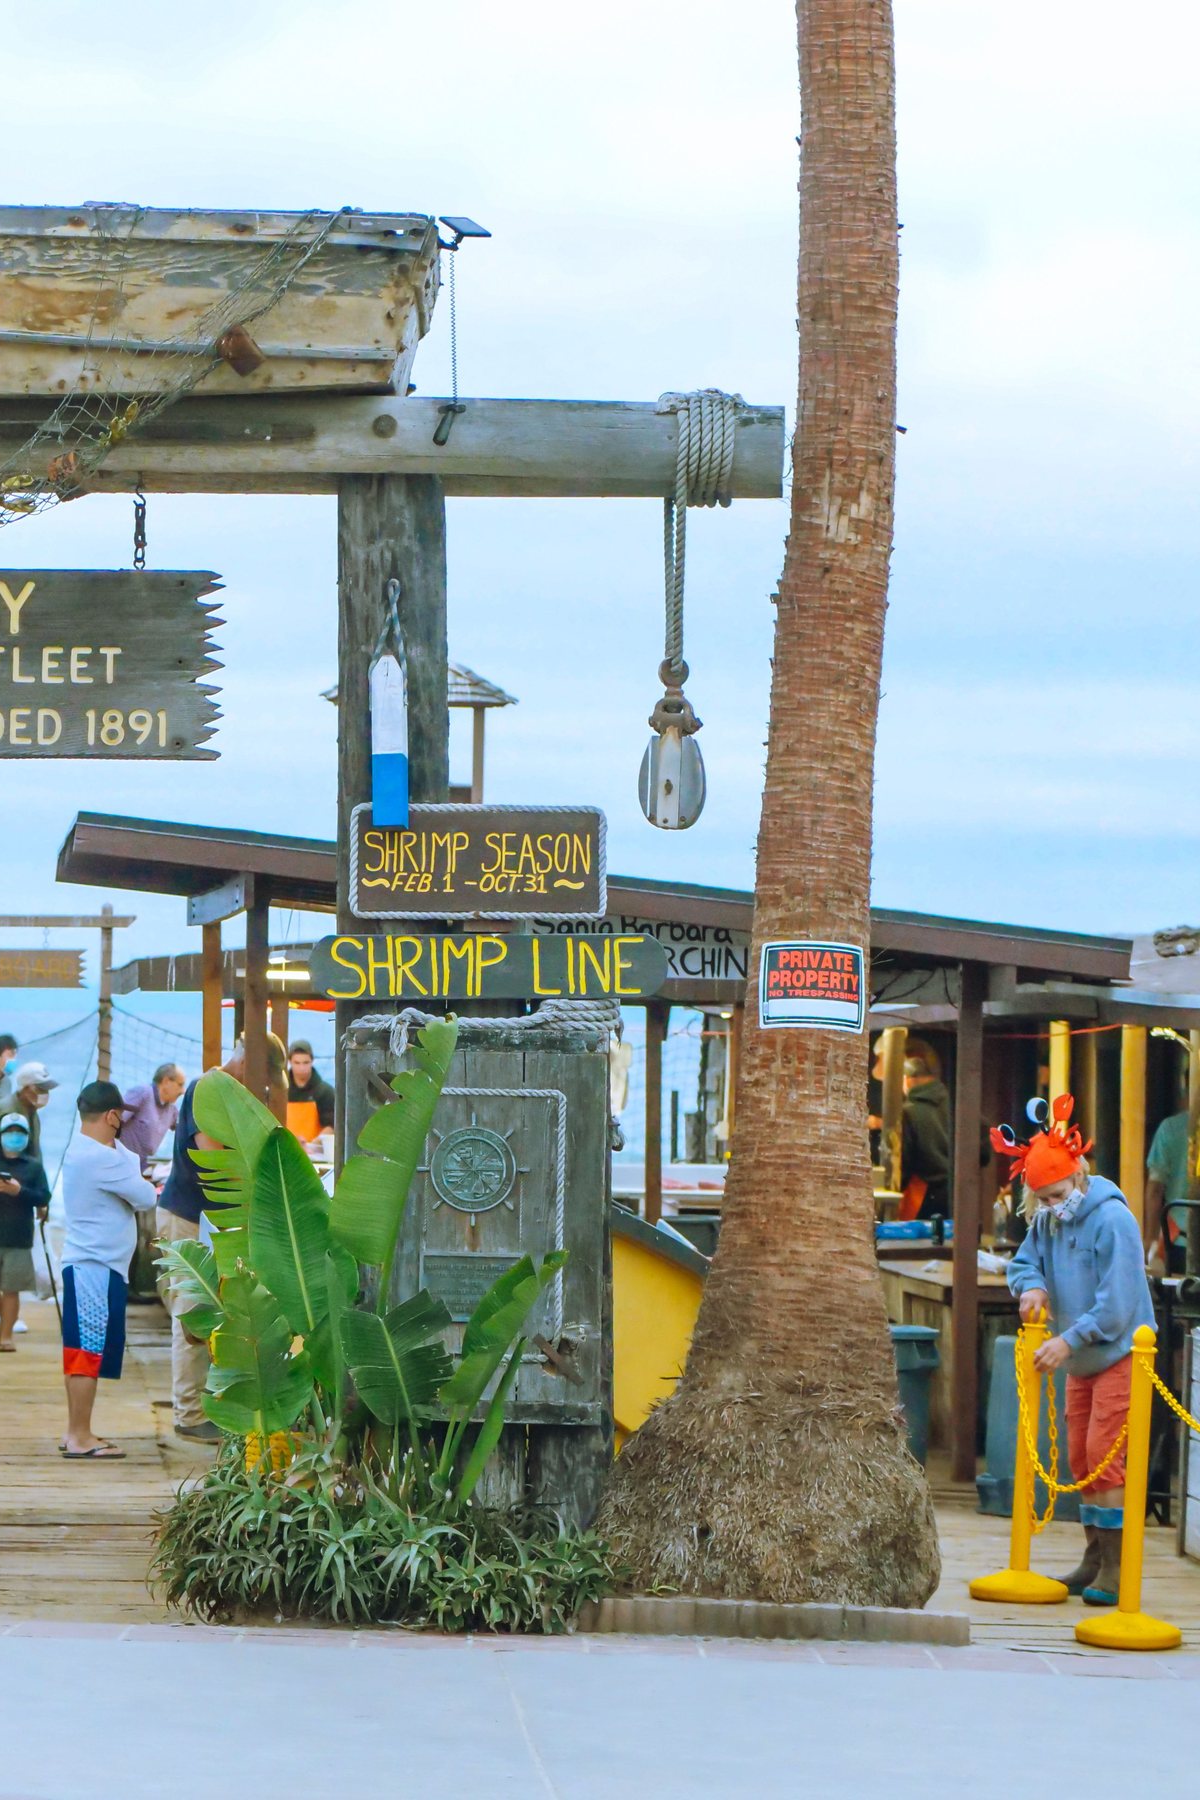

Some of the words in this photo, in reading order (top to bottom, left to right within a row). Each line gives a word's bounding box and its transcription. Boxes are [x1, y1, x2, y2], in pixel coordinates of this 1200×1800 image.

[85, 708, 168, 746] 1891
[364, 831, 470, 873] SHRIMP
[481, 832, 591, 874] SEASON
[326, 935, 508, 998] SHRIMP
[532, 937, 644, 996] LINE
[778, 950, 854, 972] PRIVATE
[768, 969, 859, 992] PROPERTY
[768, 989, 784, 997] NO
[787, 989, 859, 1001] TRESPASSING
